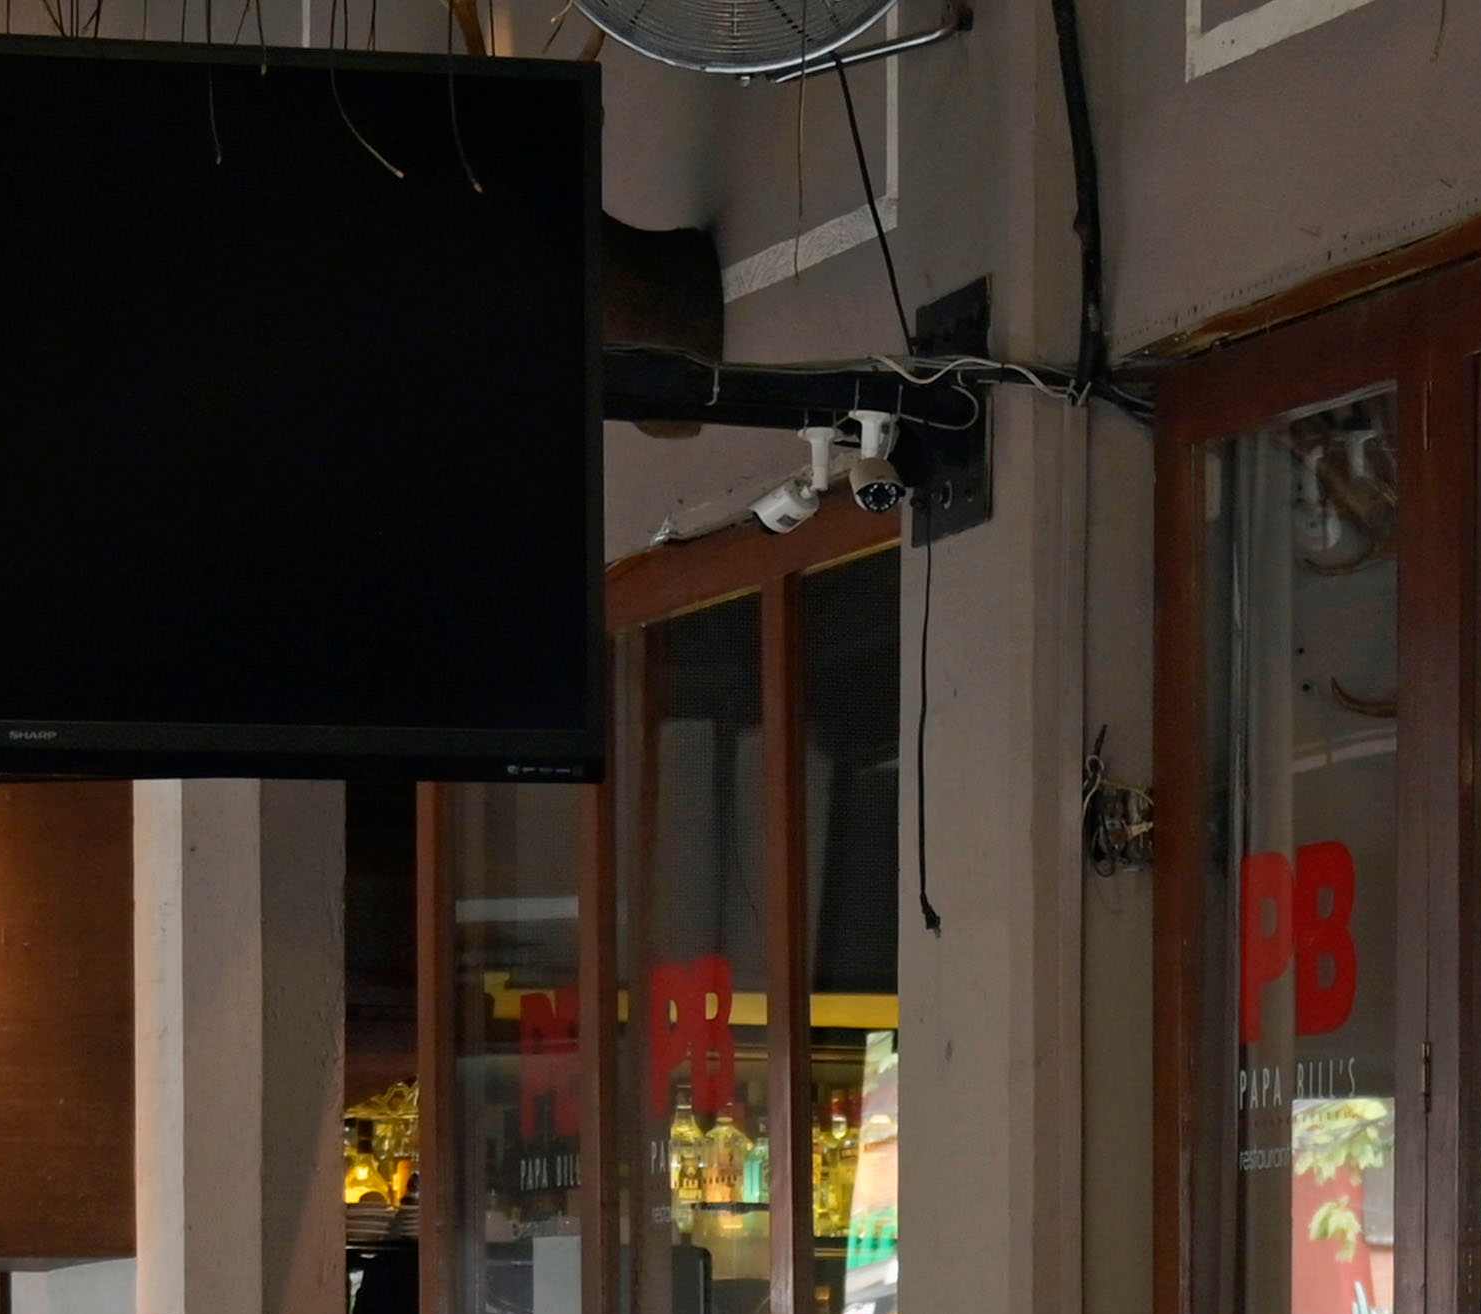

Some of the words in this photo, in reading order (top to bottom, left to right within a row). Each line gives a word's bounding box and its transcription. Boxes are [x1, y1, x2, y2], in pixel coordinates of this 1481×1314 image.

[1239, 841, 1358, 1043] PB
[1239, 1066, 1283, 1111] PAPA
[1296, 1057, 1357, 1101] BILL'S
[520, 1156, 549, 1192] PAPA
[556, 1153, 582, 1188] BILL
